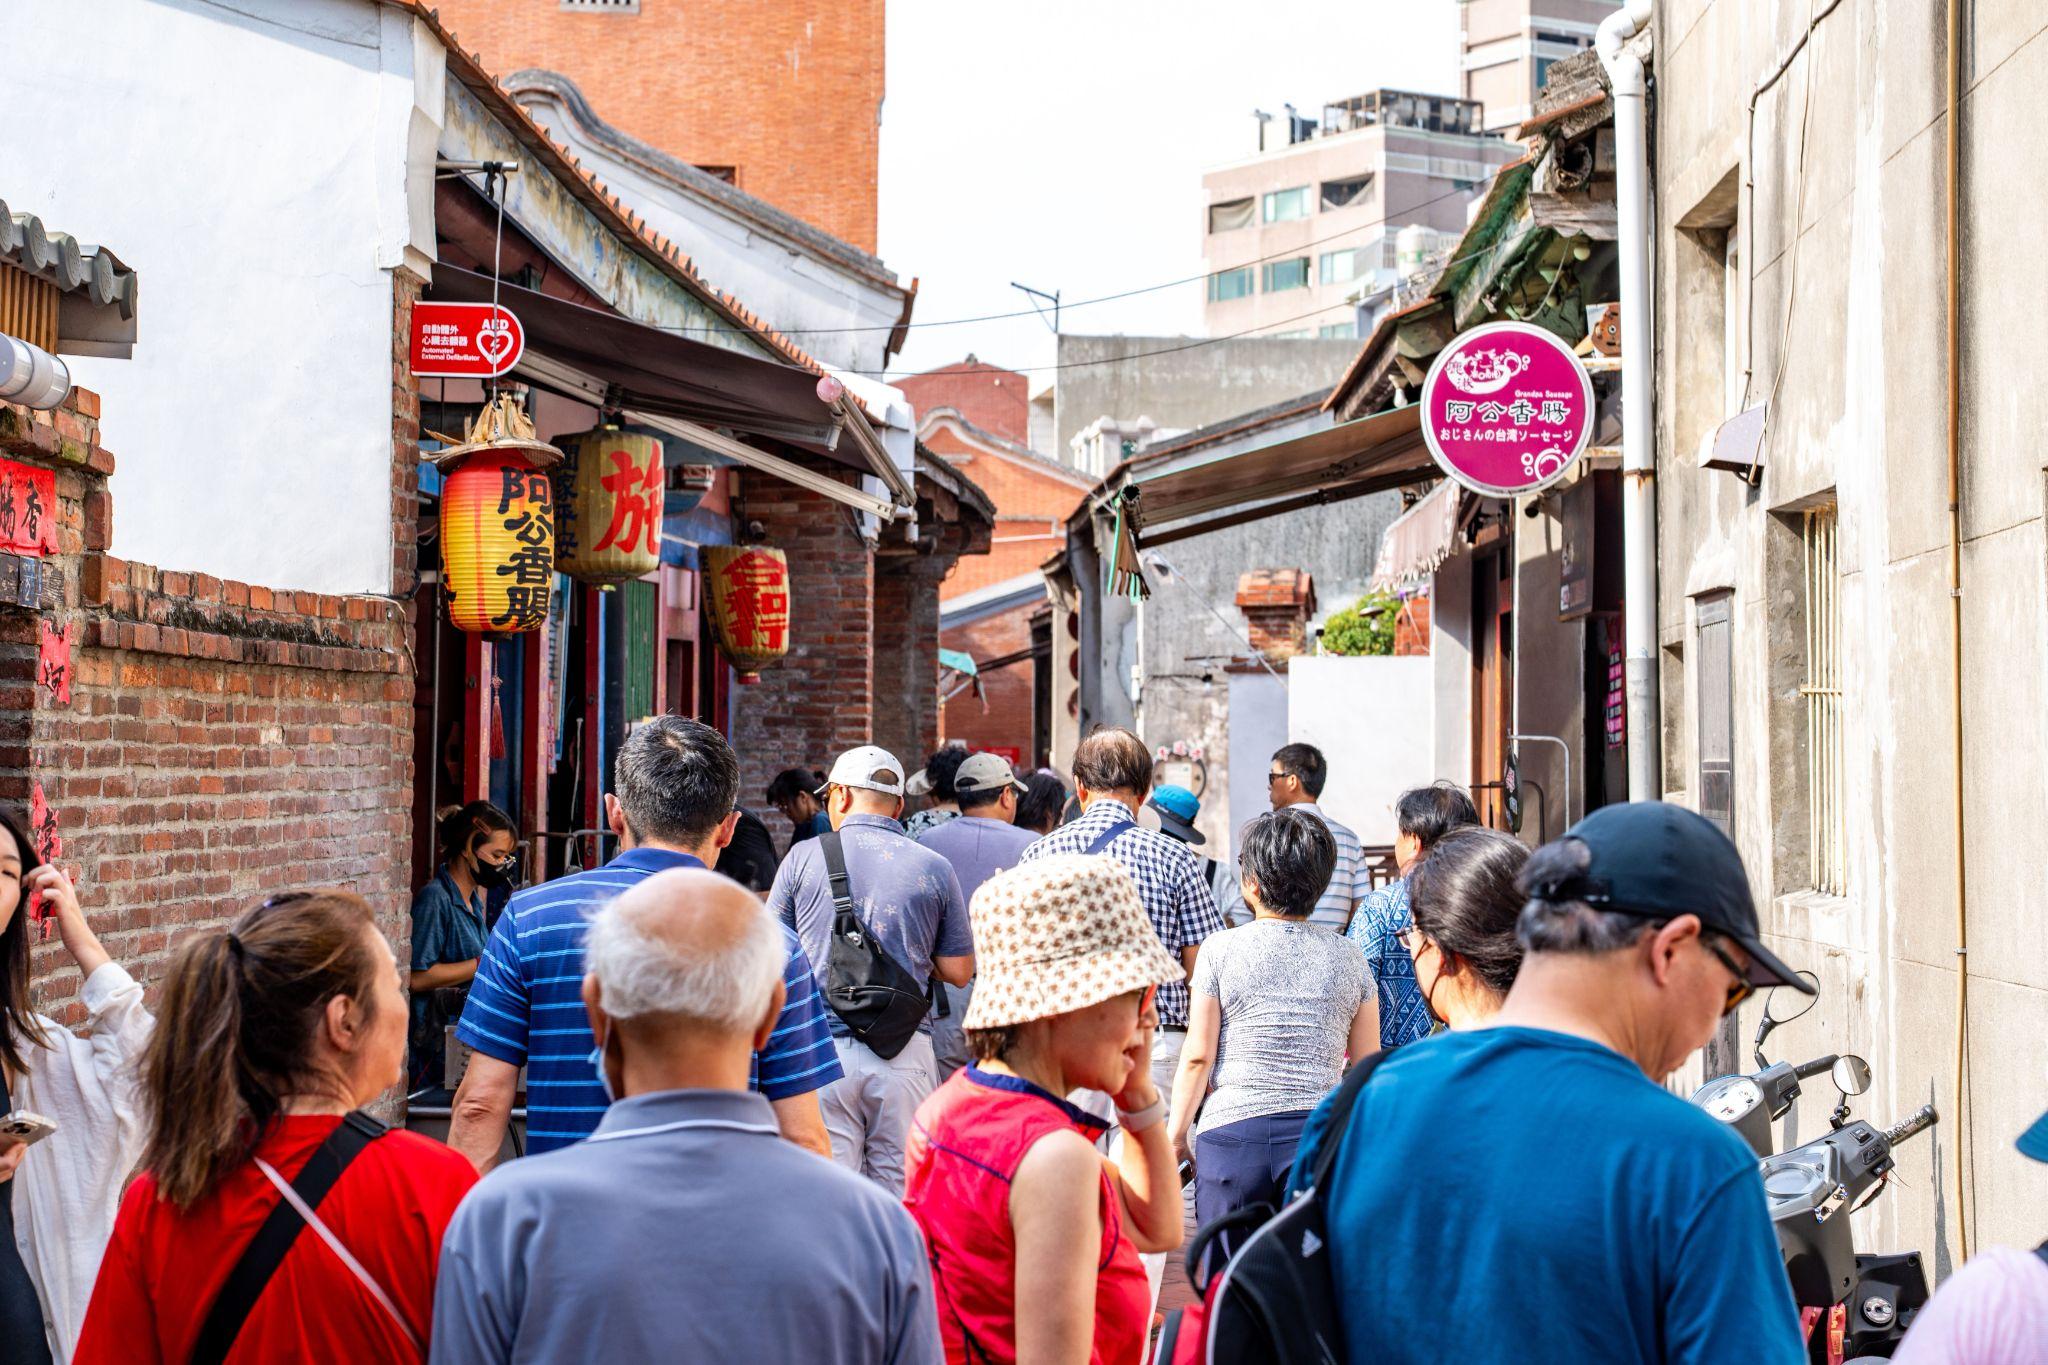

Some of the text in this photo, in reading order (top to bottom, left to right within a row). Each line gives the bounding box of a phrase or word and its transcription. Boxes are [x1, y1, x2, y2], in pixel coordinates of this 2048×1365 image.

[422, 324, 459, 335] 自動體外
[482, 319, 510, 330] AED
[421, 346, 454, 354] Automated
[1514, 389, 1573, 399] Grandpa Sausage
[1440, 428, 1573, 442] おじさんの台湾ソーセージ
[592, 440, 664, 556] 施
